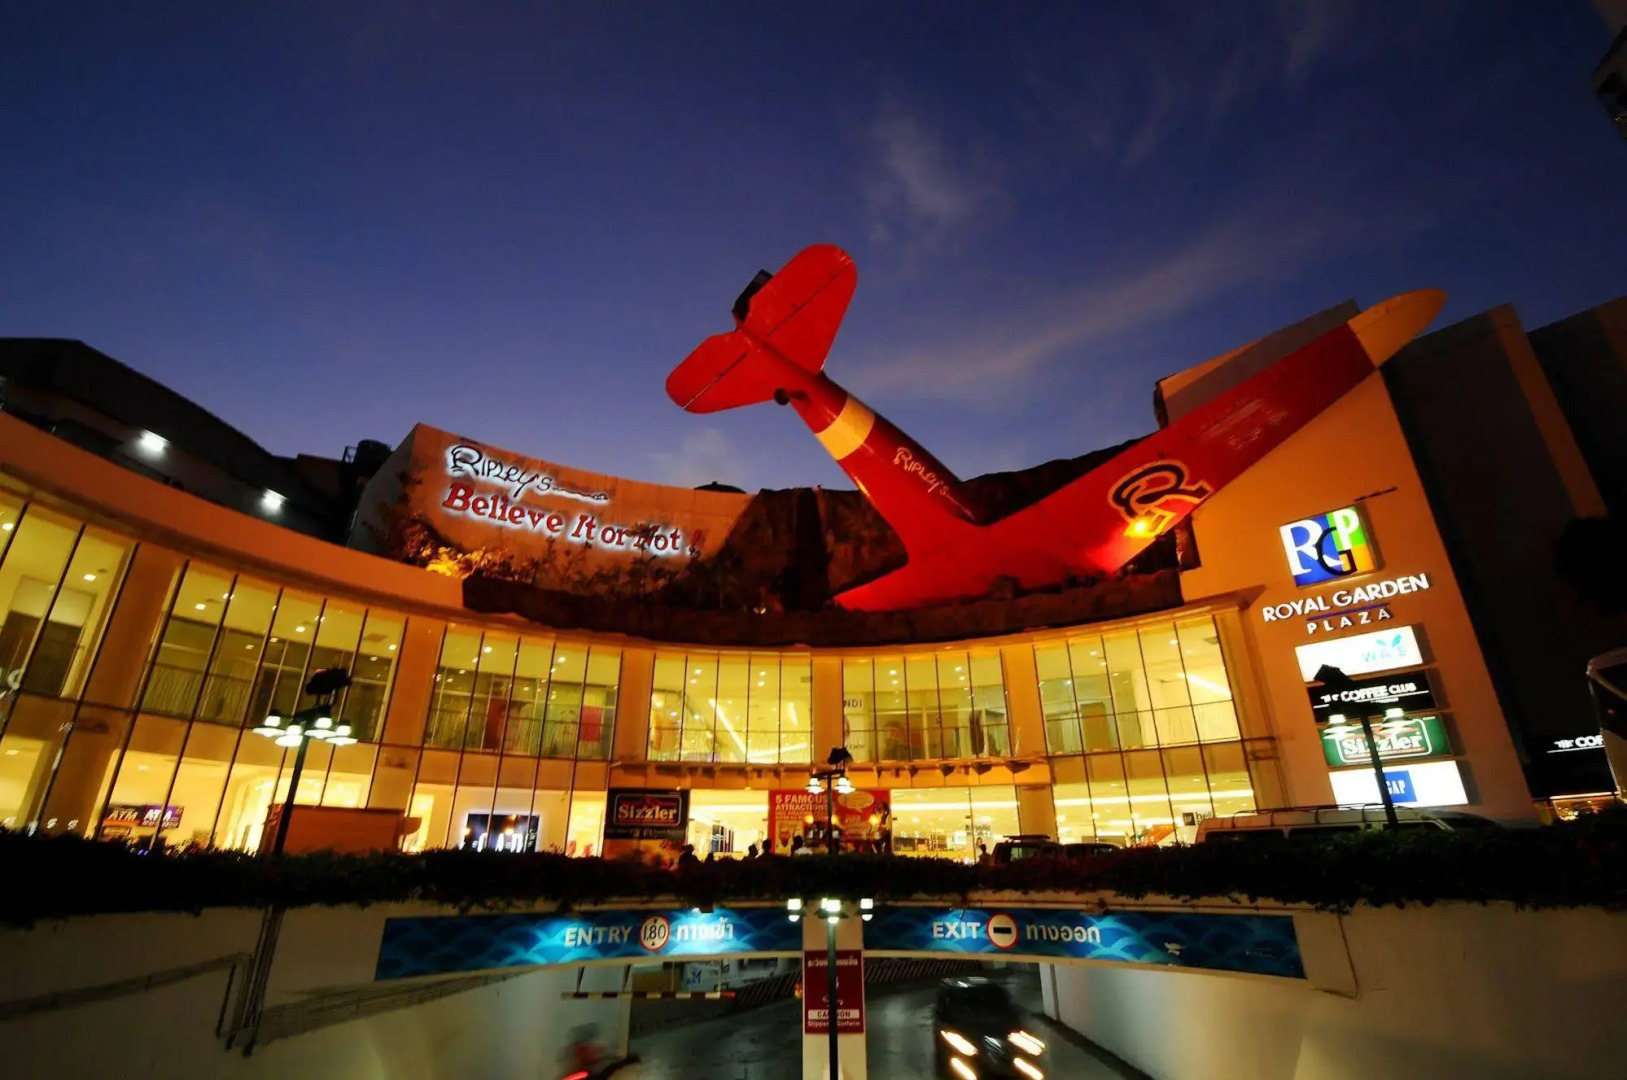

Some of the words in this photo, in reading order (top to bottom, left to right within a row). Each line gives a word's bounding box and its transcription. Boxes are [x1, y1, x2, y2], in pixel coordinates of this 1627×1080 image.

[442, 483, 563, 533] Believe
[571, 514, 597, 541] It
[601, 524, 630, 547] or
[1262, 595, 1330, 622] ROYAL
[1333, 573, 1430, 607] GARDEN
[1307, 608, 1391, 634] PLAZA
[1340, 685, 1389, 702] COFFEE
[1389, 682, 1417, 695] CLUB
[107, 810, 138, 821] ATM
[618, 804, 677, 820] Sizzler
[564, 926, 633, 947] ENTRY
[933, 922, 981, 939] EXIT
